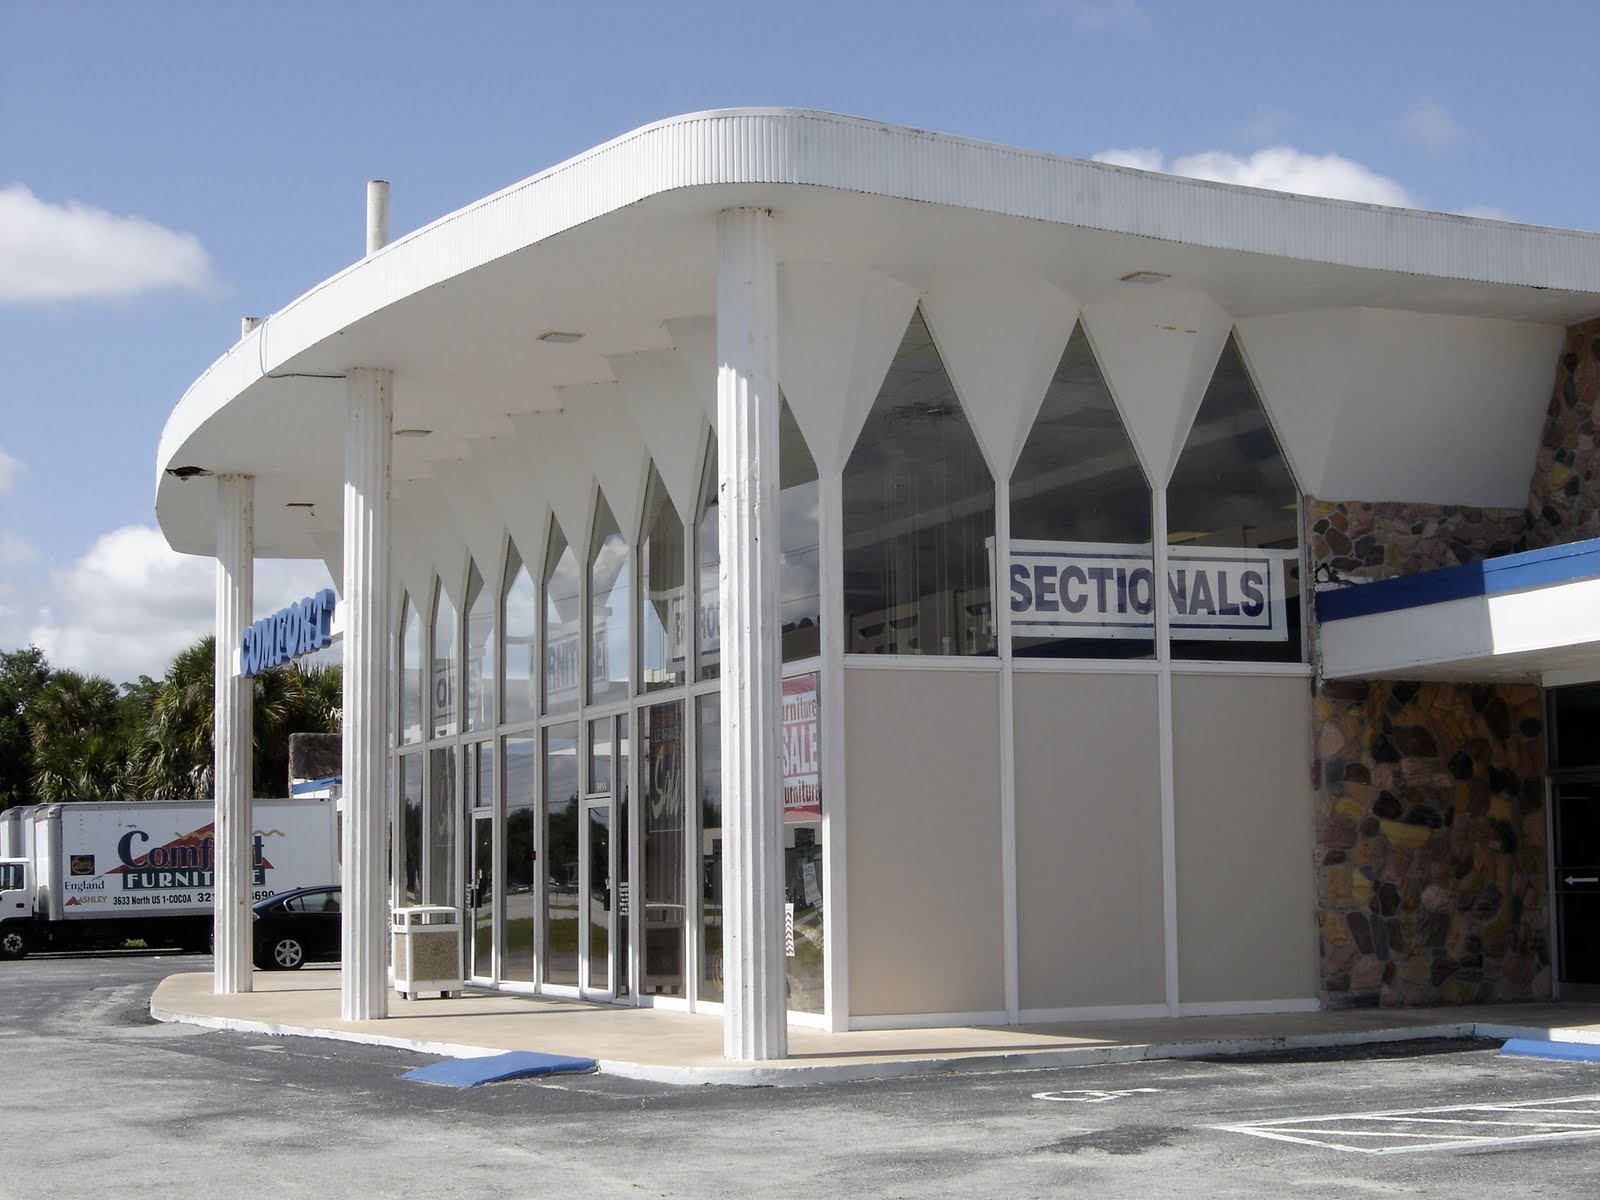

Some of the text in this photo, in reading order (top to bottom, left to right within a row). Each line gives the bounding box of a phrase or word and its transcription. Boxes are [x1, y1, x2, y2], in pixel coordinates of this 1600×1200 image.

[1009, 563, 1265, 617] SECTIONALS
[240, 588, 335, 678] COMFORT
[782, 697, 817, 721] rniture
[782, 722, 818, 776] SALE
[117, 830, 264, 871] Comft
[64, 880, 105, 892] England
[127, 869, 261, 888] FURNITE
[113, 896, 130, 906] 3633
[131, 895, 150, 905] North
[152, 895, 160, 904] US
